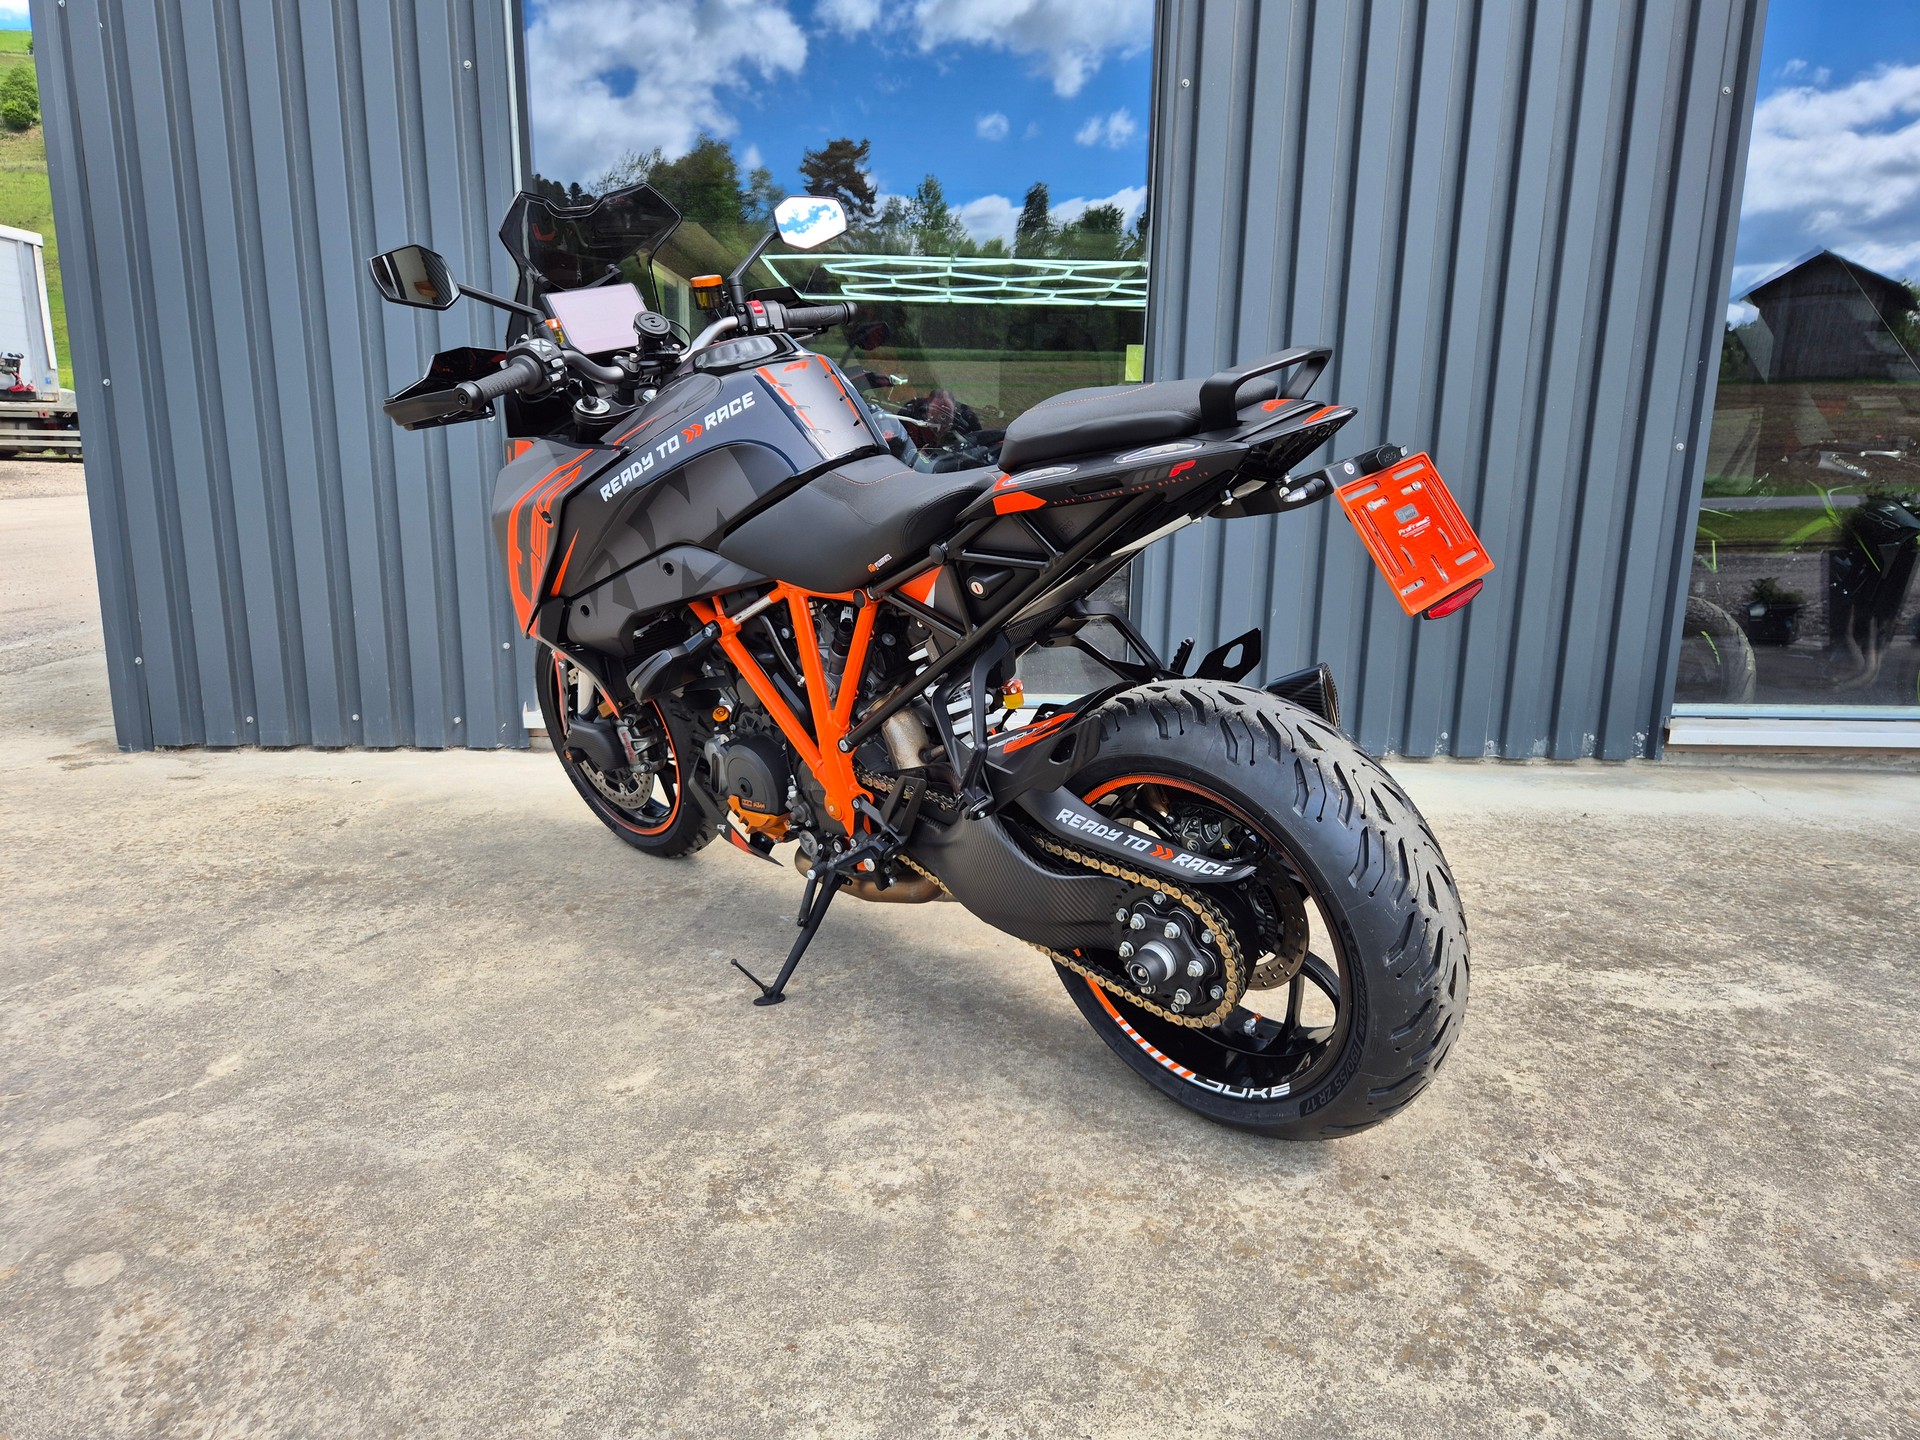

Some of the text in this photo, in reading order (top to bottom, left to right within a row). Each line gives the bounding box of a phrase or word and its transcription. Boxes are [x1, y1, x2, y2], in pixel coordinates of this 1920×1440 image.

[600, 391, 756, 502] READY TO RACE
[1055, 808, 1233, 876] READY TO RACE
[1305, 953, 1367, 1114] MICHELIN 190/55 ZR 17
[1188, 1078, 1291, 1099] DUKE
